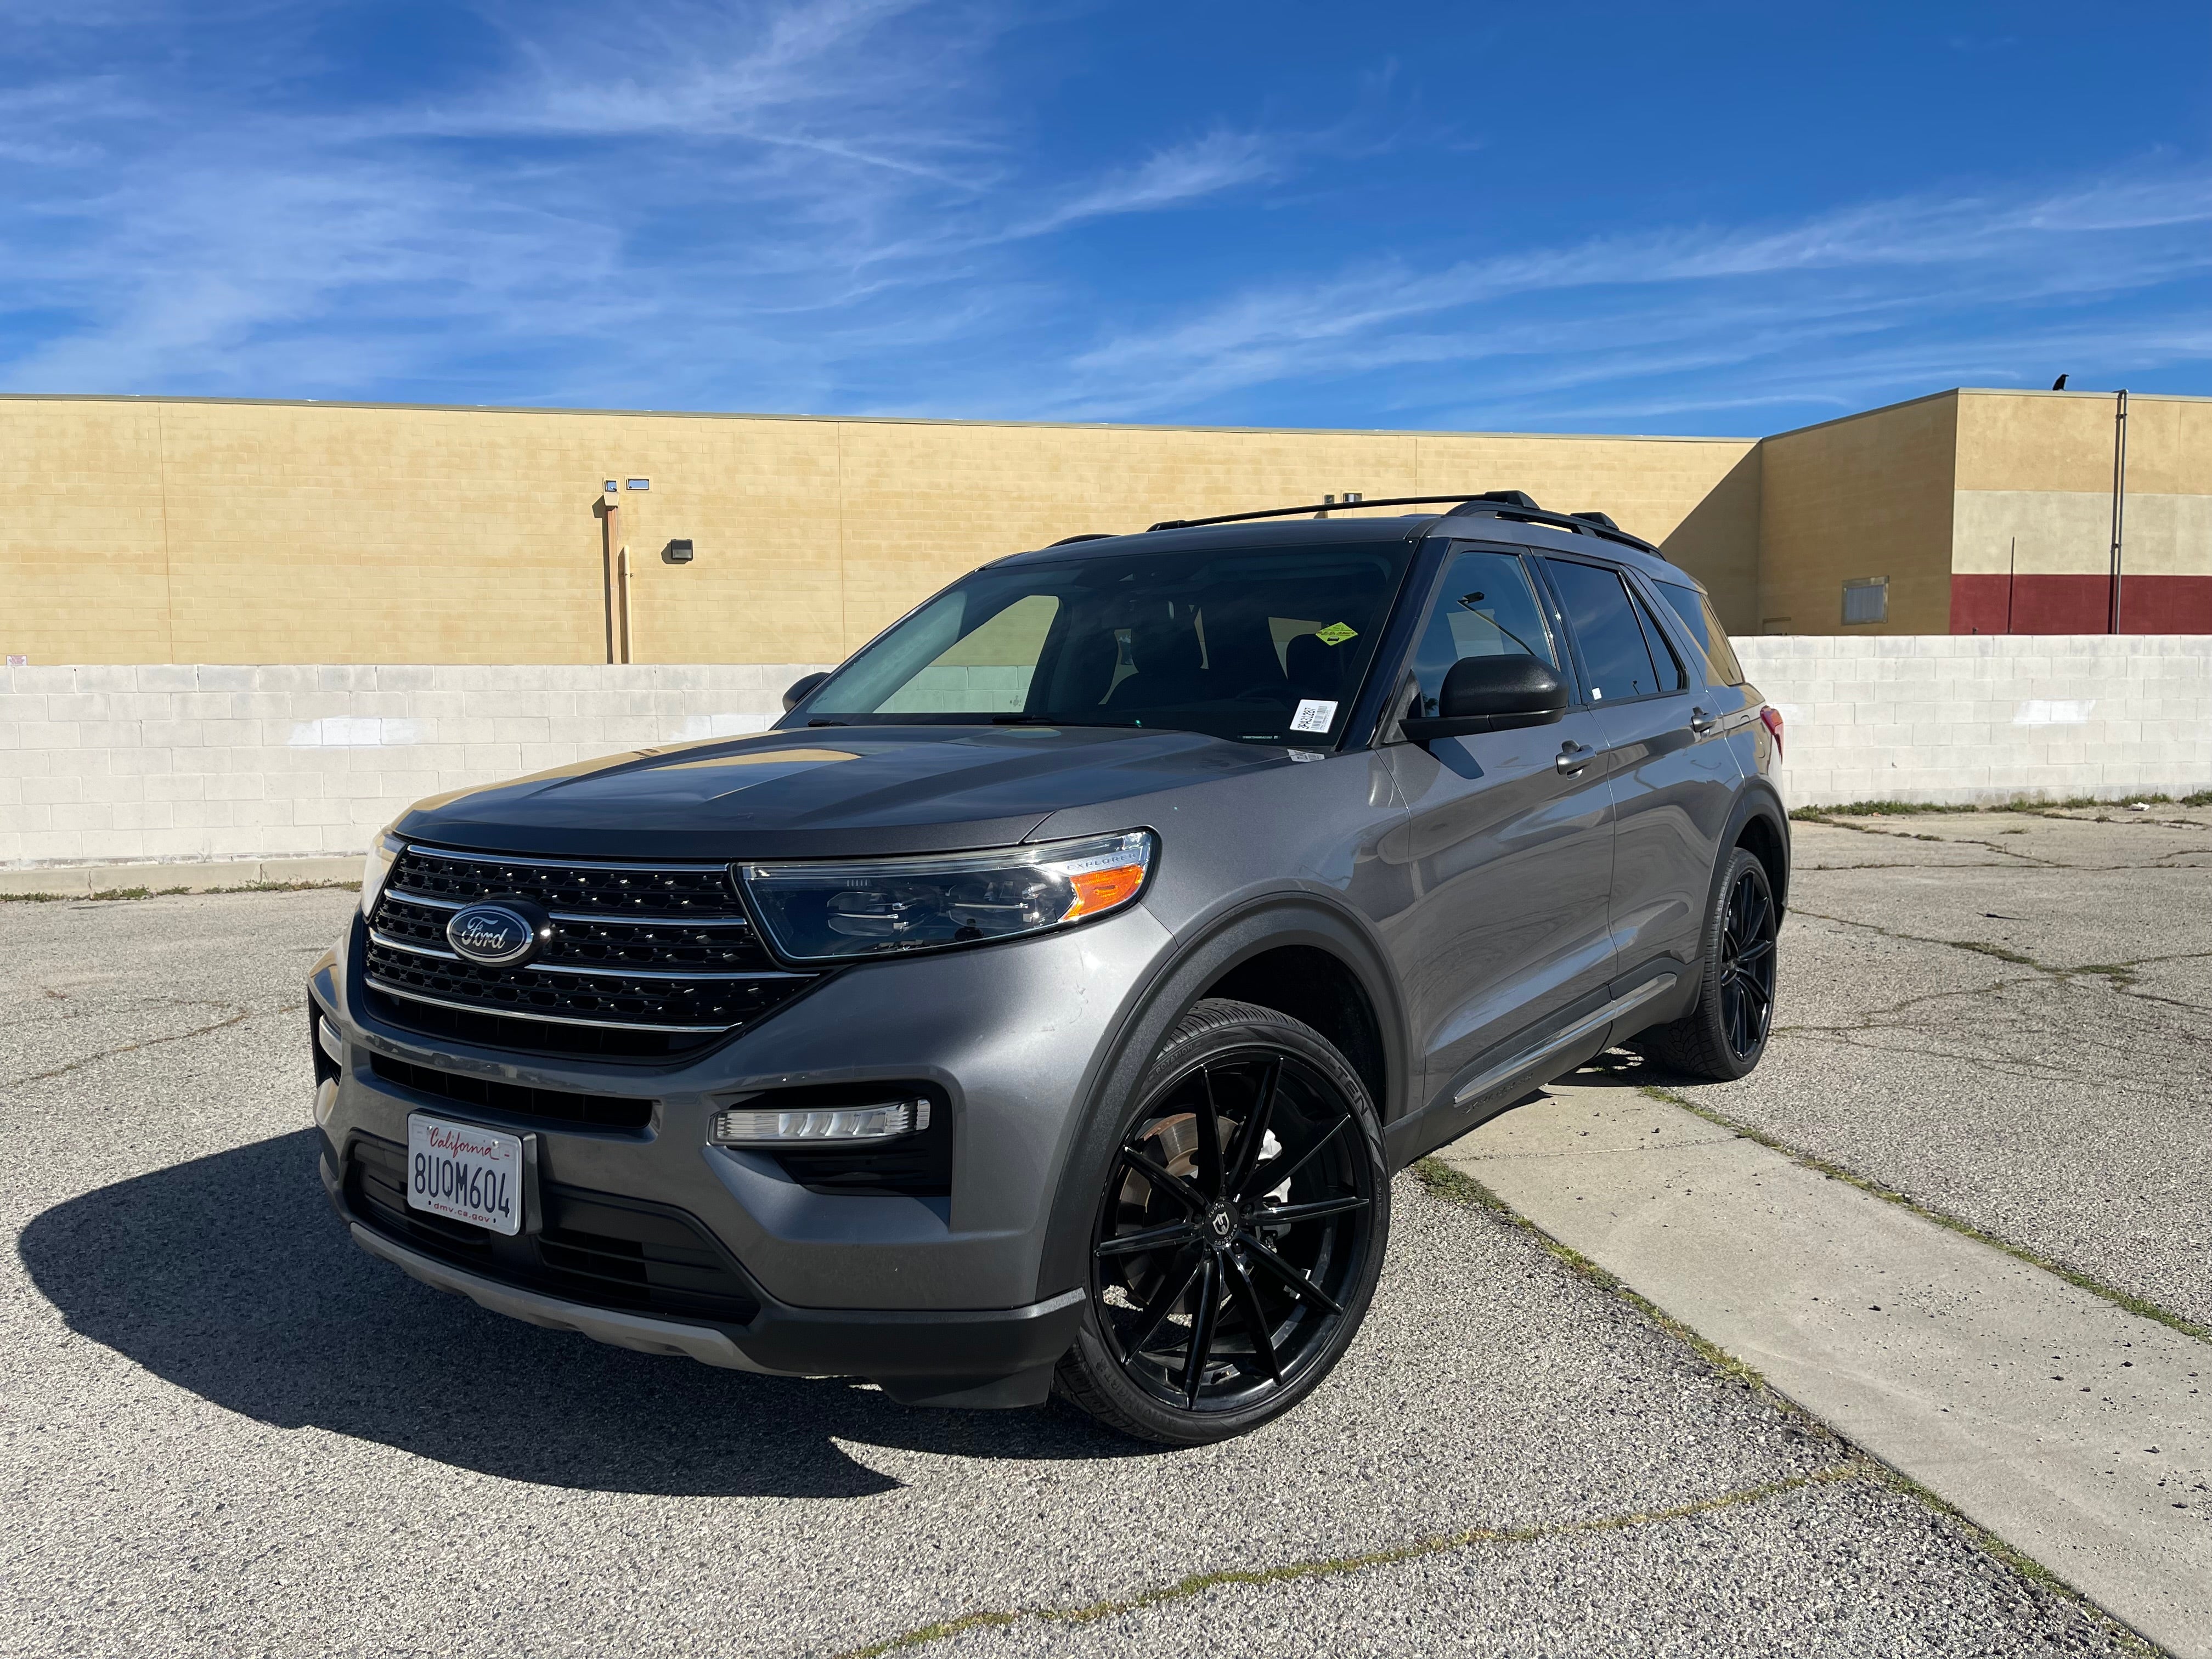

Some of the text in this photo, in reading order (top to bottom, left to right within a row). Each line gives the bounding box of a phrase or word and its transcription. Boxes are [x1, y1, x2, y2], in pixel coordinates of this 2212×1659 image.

[1297, 707, 1316, 730] 3PA31287
[1067, 853, 1136, 870] EXPLORER
[461, 916, 509, 949] Ford
[1155, 1045, 1193, 1075] ROTATION
[430, 1127, 499, 1160] California
[415, 1153, 510, 1218] 8UQM604
[434, 1203, 490, 1223] dmv.ca.gov
[1208, 1203, 1224, 1218] CURVA
[1214, 1223, 1238, 1245] CONCEPTS
